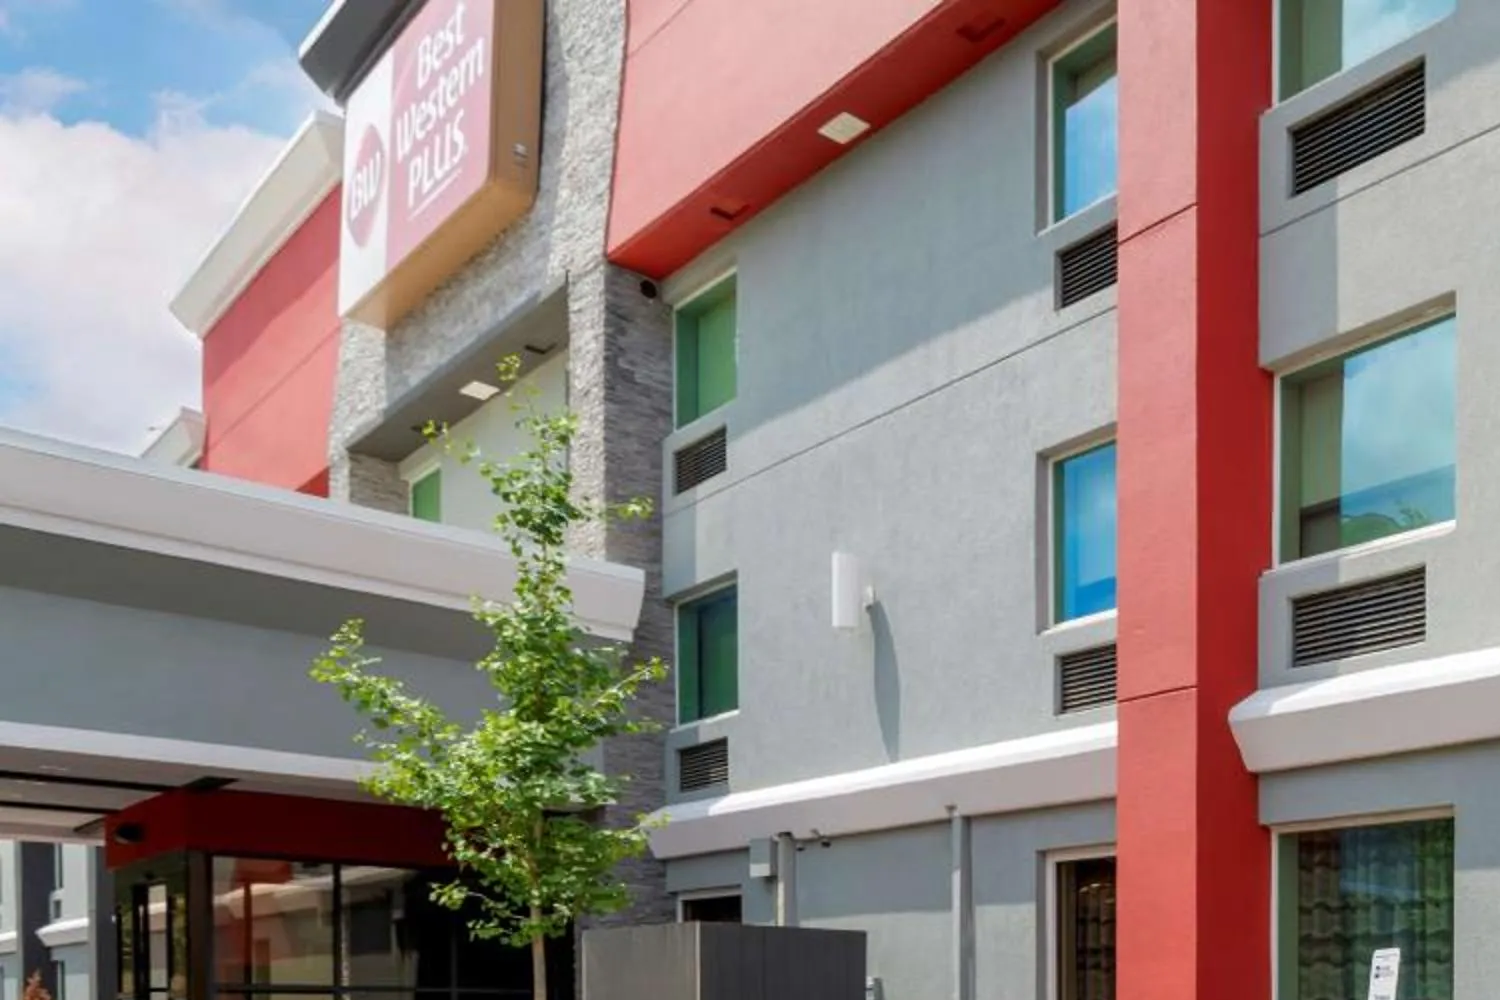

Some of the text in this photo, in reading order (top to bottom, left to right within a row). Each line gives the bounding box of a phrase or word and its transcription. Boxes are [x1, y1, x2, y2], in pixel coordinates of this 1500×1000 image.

[418, 2, 465, 90] Best
[396, 36, 484, 164] Western
[350, 150, 381, 220] BW
[407, 108, 464, 209] PLUS
